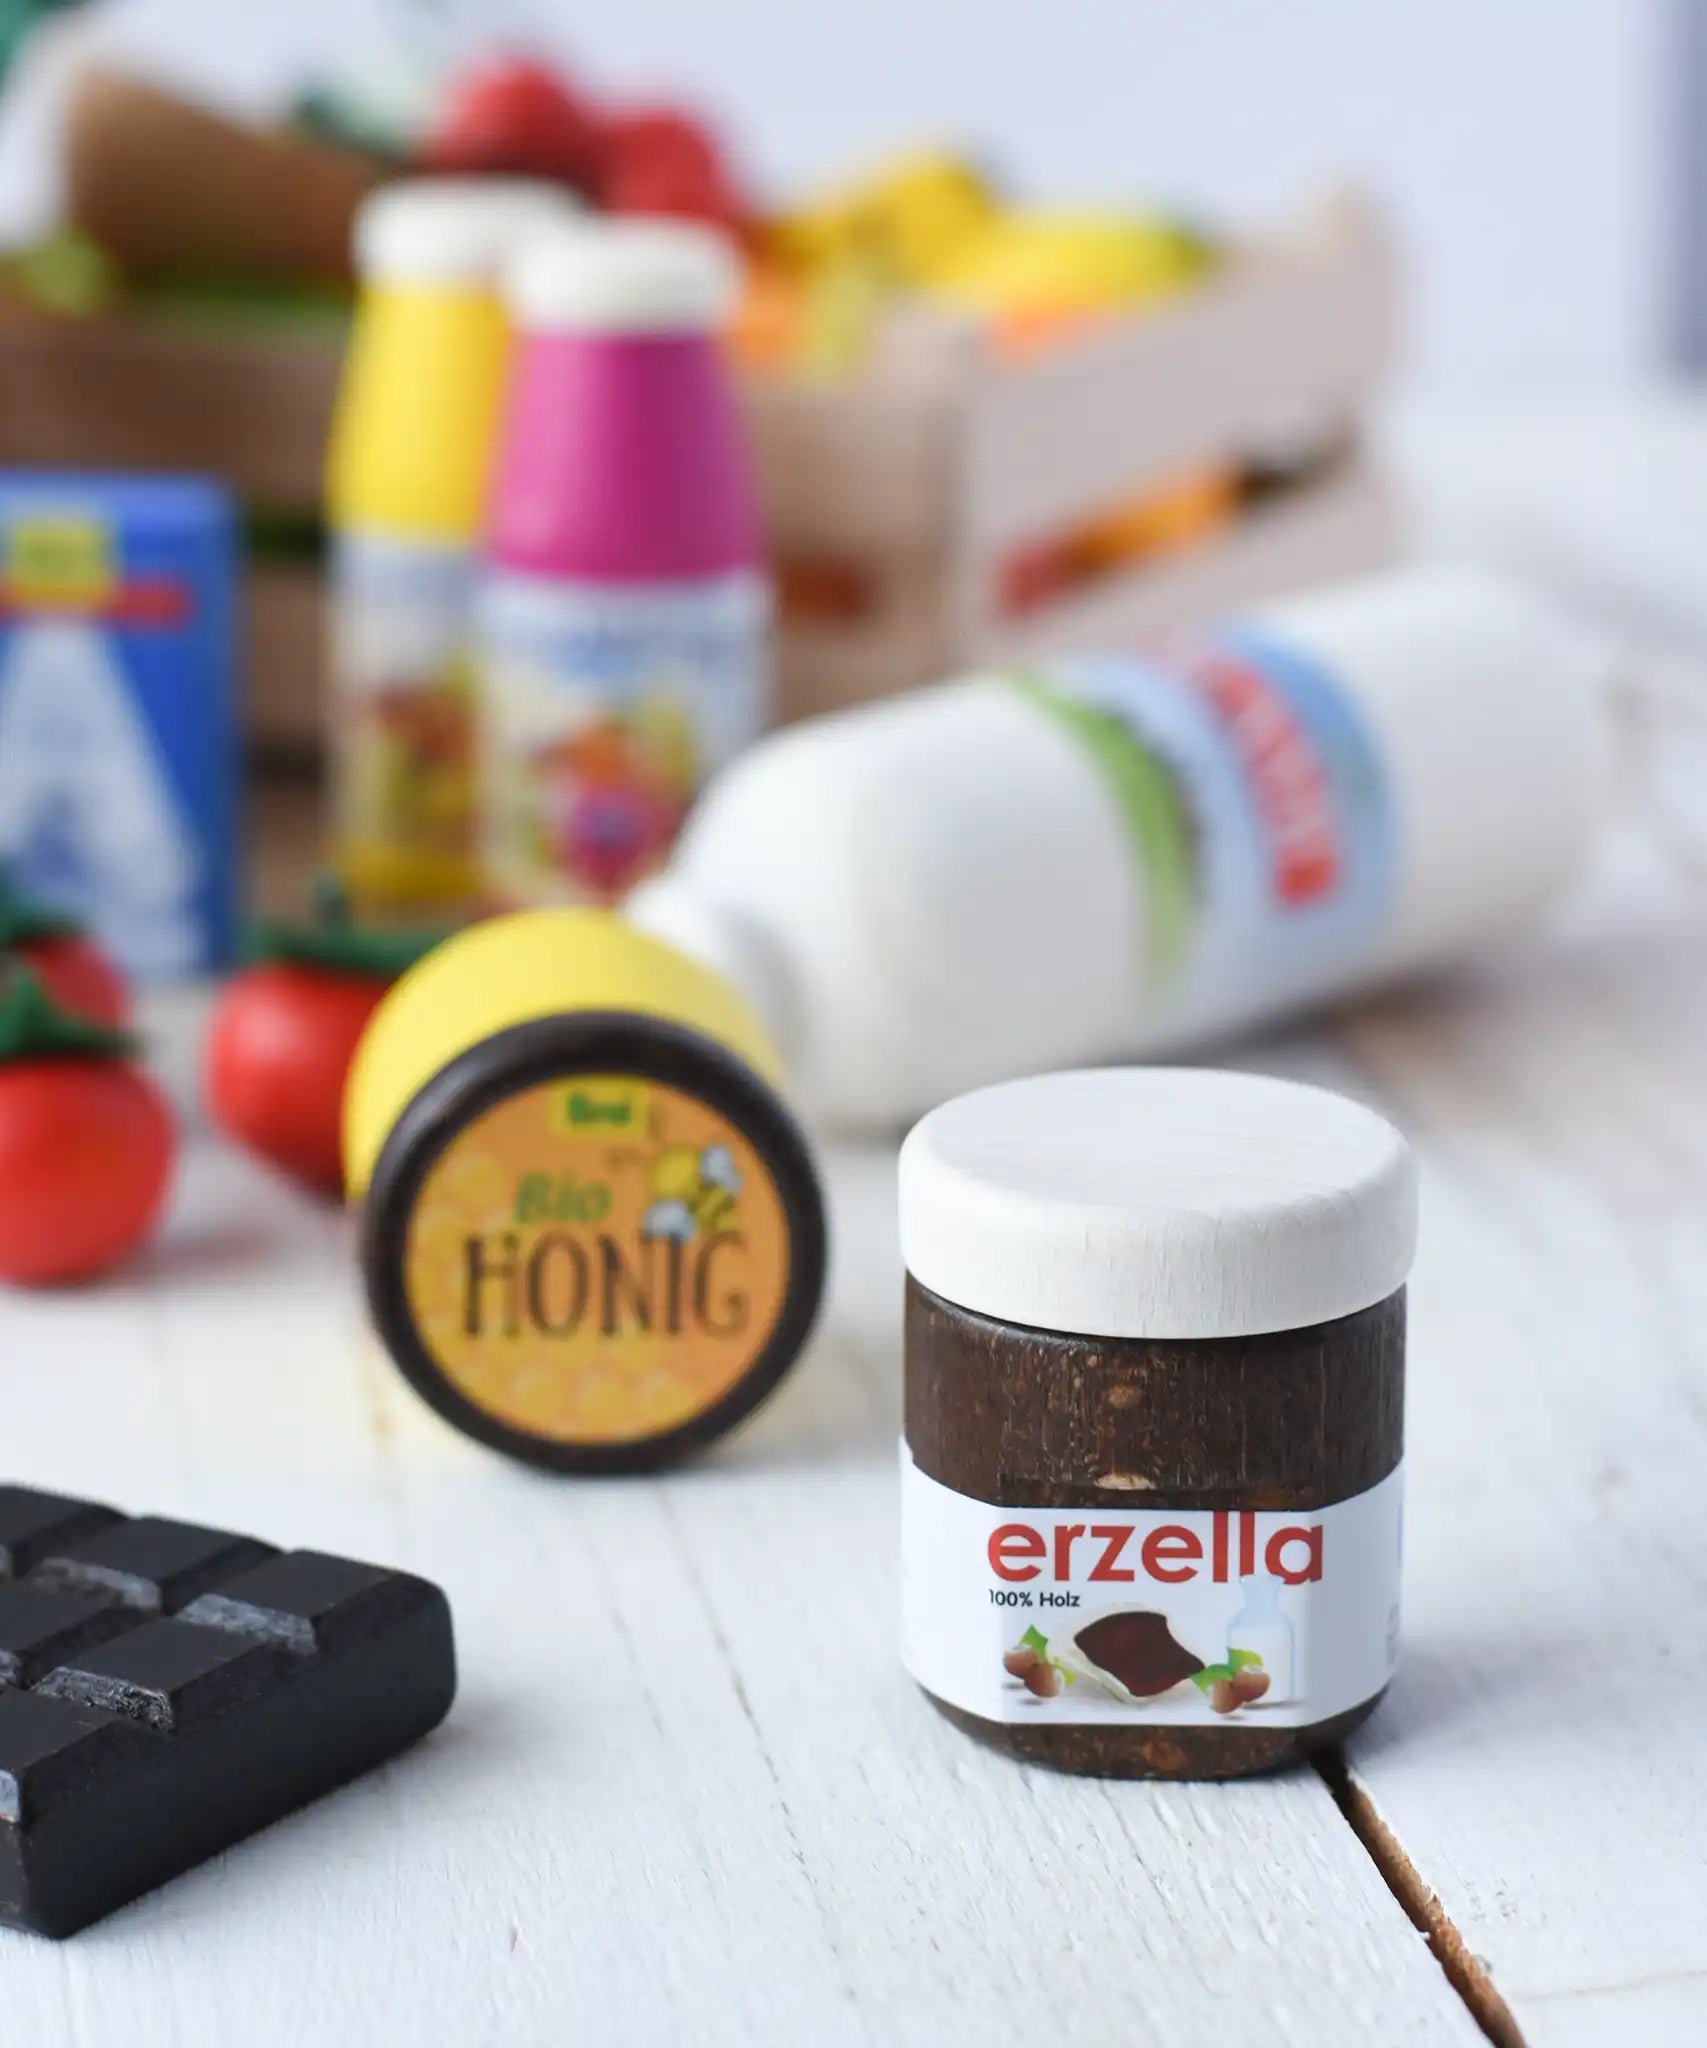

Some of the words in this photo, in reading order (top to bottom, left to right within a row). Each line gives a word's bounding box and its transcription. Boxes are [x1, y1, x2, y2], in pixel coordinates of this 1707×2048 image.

[517, 1173, 612, 1223] Bio
[464, 1229, 750, 1338] HONIG
[987, 1511, 1323, 1585] erzella
[988, 1589, 1033, 1607] 100%
[1039, 1590, 1081, 1607] Holz
